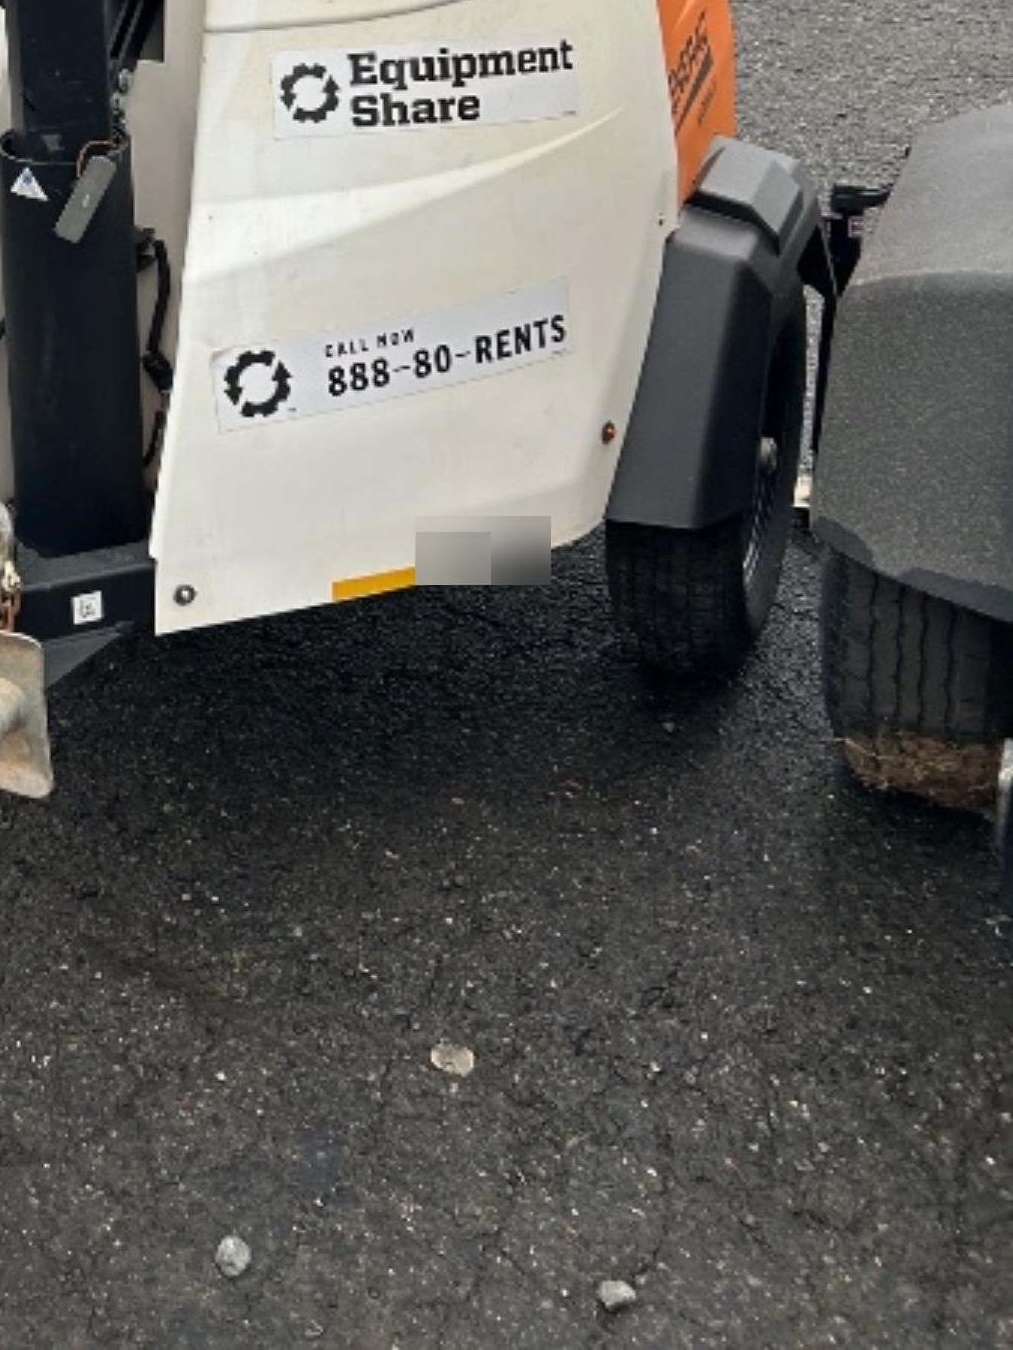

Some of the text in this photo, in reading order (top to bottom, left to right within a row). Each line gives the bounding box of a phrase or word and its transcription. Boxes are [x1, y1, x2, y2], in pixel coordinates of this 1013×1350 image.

[347, 38, 573, 90] Equipment
[350, 92, 481, 127] Share
[325, 328, 415, 358] CALL NOW
[328, 314, 566, 397] 888-80-RENTS
